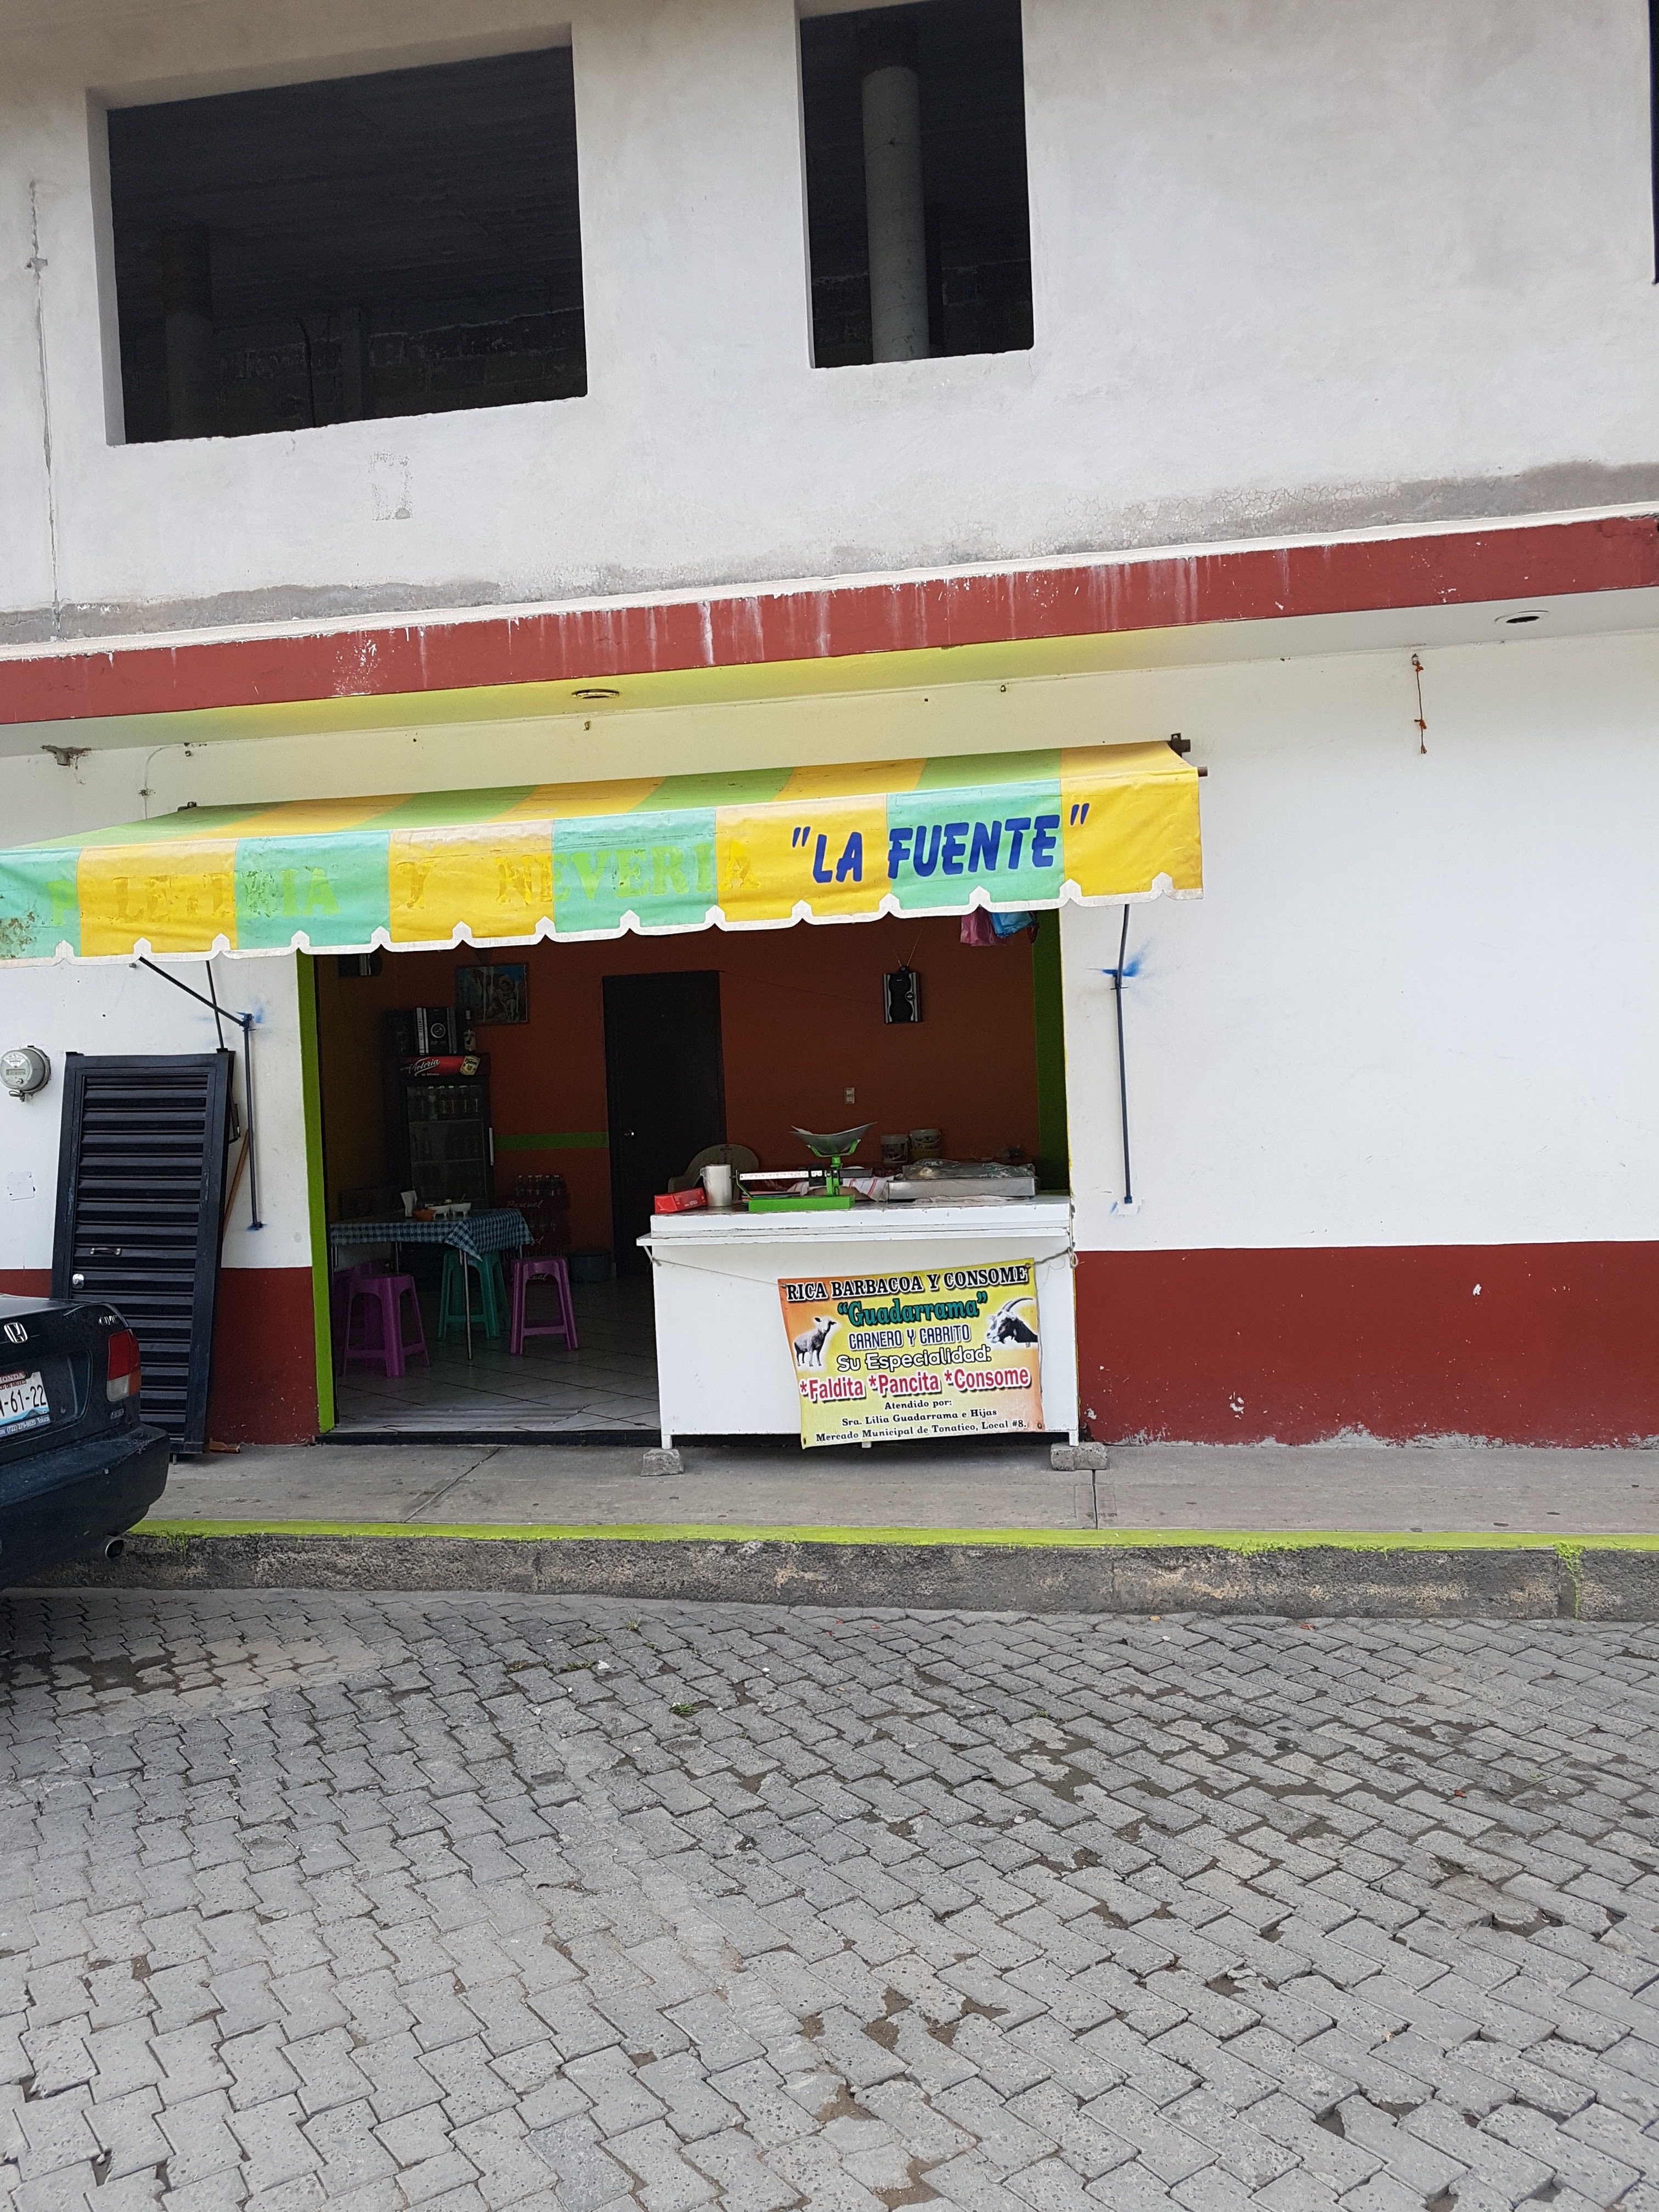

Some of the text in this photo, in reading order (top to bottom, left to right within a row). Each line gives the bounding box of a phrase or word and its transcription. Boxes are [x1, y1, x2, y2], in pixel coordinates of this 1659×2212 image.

[787, 1265, 1027, 1301] RICA BARBACOA Y CONSOME
[849, 1324, 970, 1350] CARNERO Y CABRITO
[837, 1344, 992, 1372] Su Especialidad:
[884, 1400, 952, 1410] Atendido por:
[842, 1418, 862, 1426] Sra.
[865, 1415, 889, 1425] Lilia
[893, 1413, 958, 1423] Guadarrama
[970, 1409, 997, 1418] Hijas
[816, 1419, 1026, 1442] Mercado Municipal de Tonatico, Local #8.
